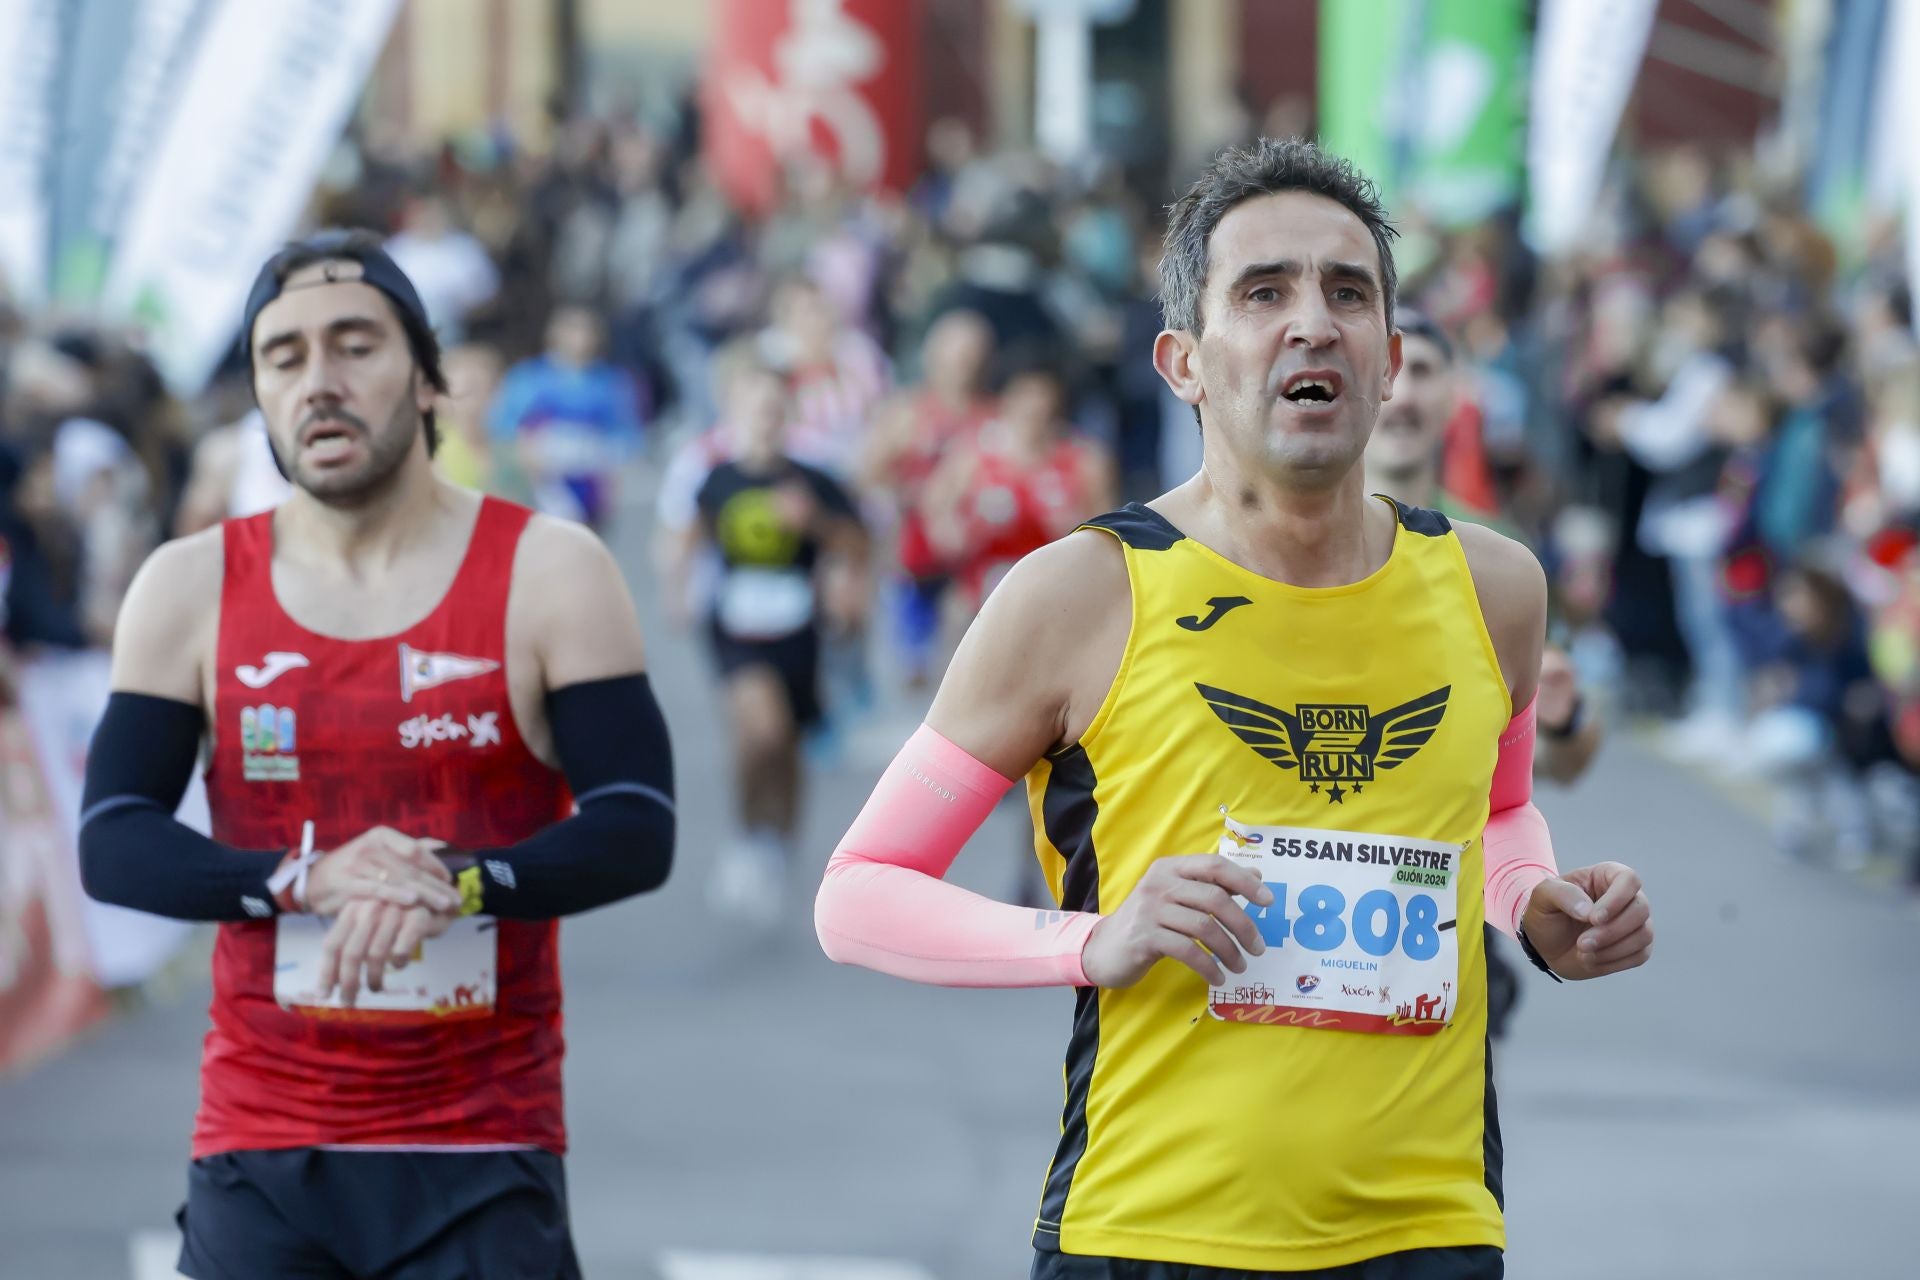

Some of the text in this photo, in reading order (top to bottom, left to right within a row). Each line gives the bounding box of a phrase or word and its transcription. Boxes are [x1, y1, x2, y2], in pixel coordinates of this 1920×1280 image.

[1302, 709, 1365, 730] BORN
[1305, 754, 1369, 778] RUN
[1271, 837, 1451, 871] 55 SAN SILVESTRE
[1396, 869, 1446, 886] GIJÓN 2024
[1243, 882, 1440, 962] 4808
[1320, 958, 1378, 972] MIGUELIN
